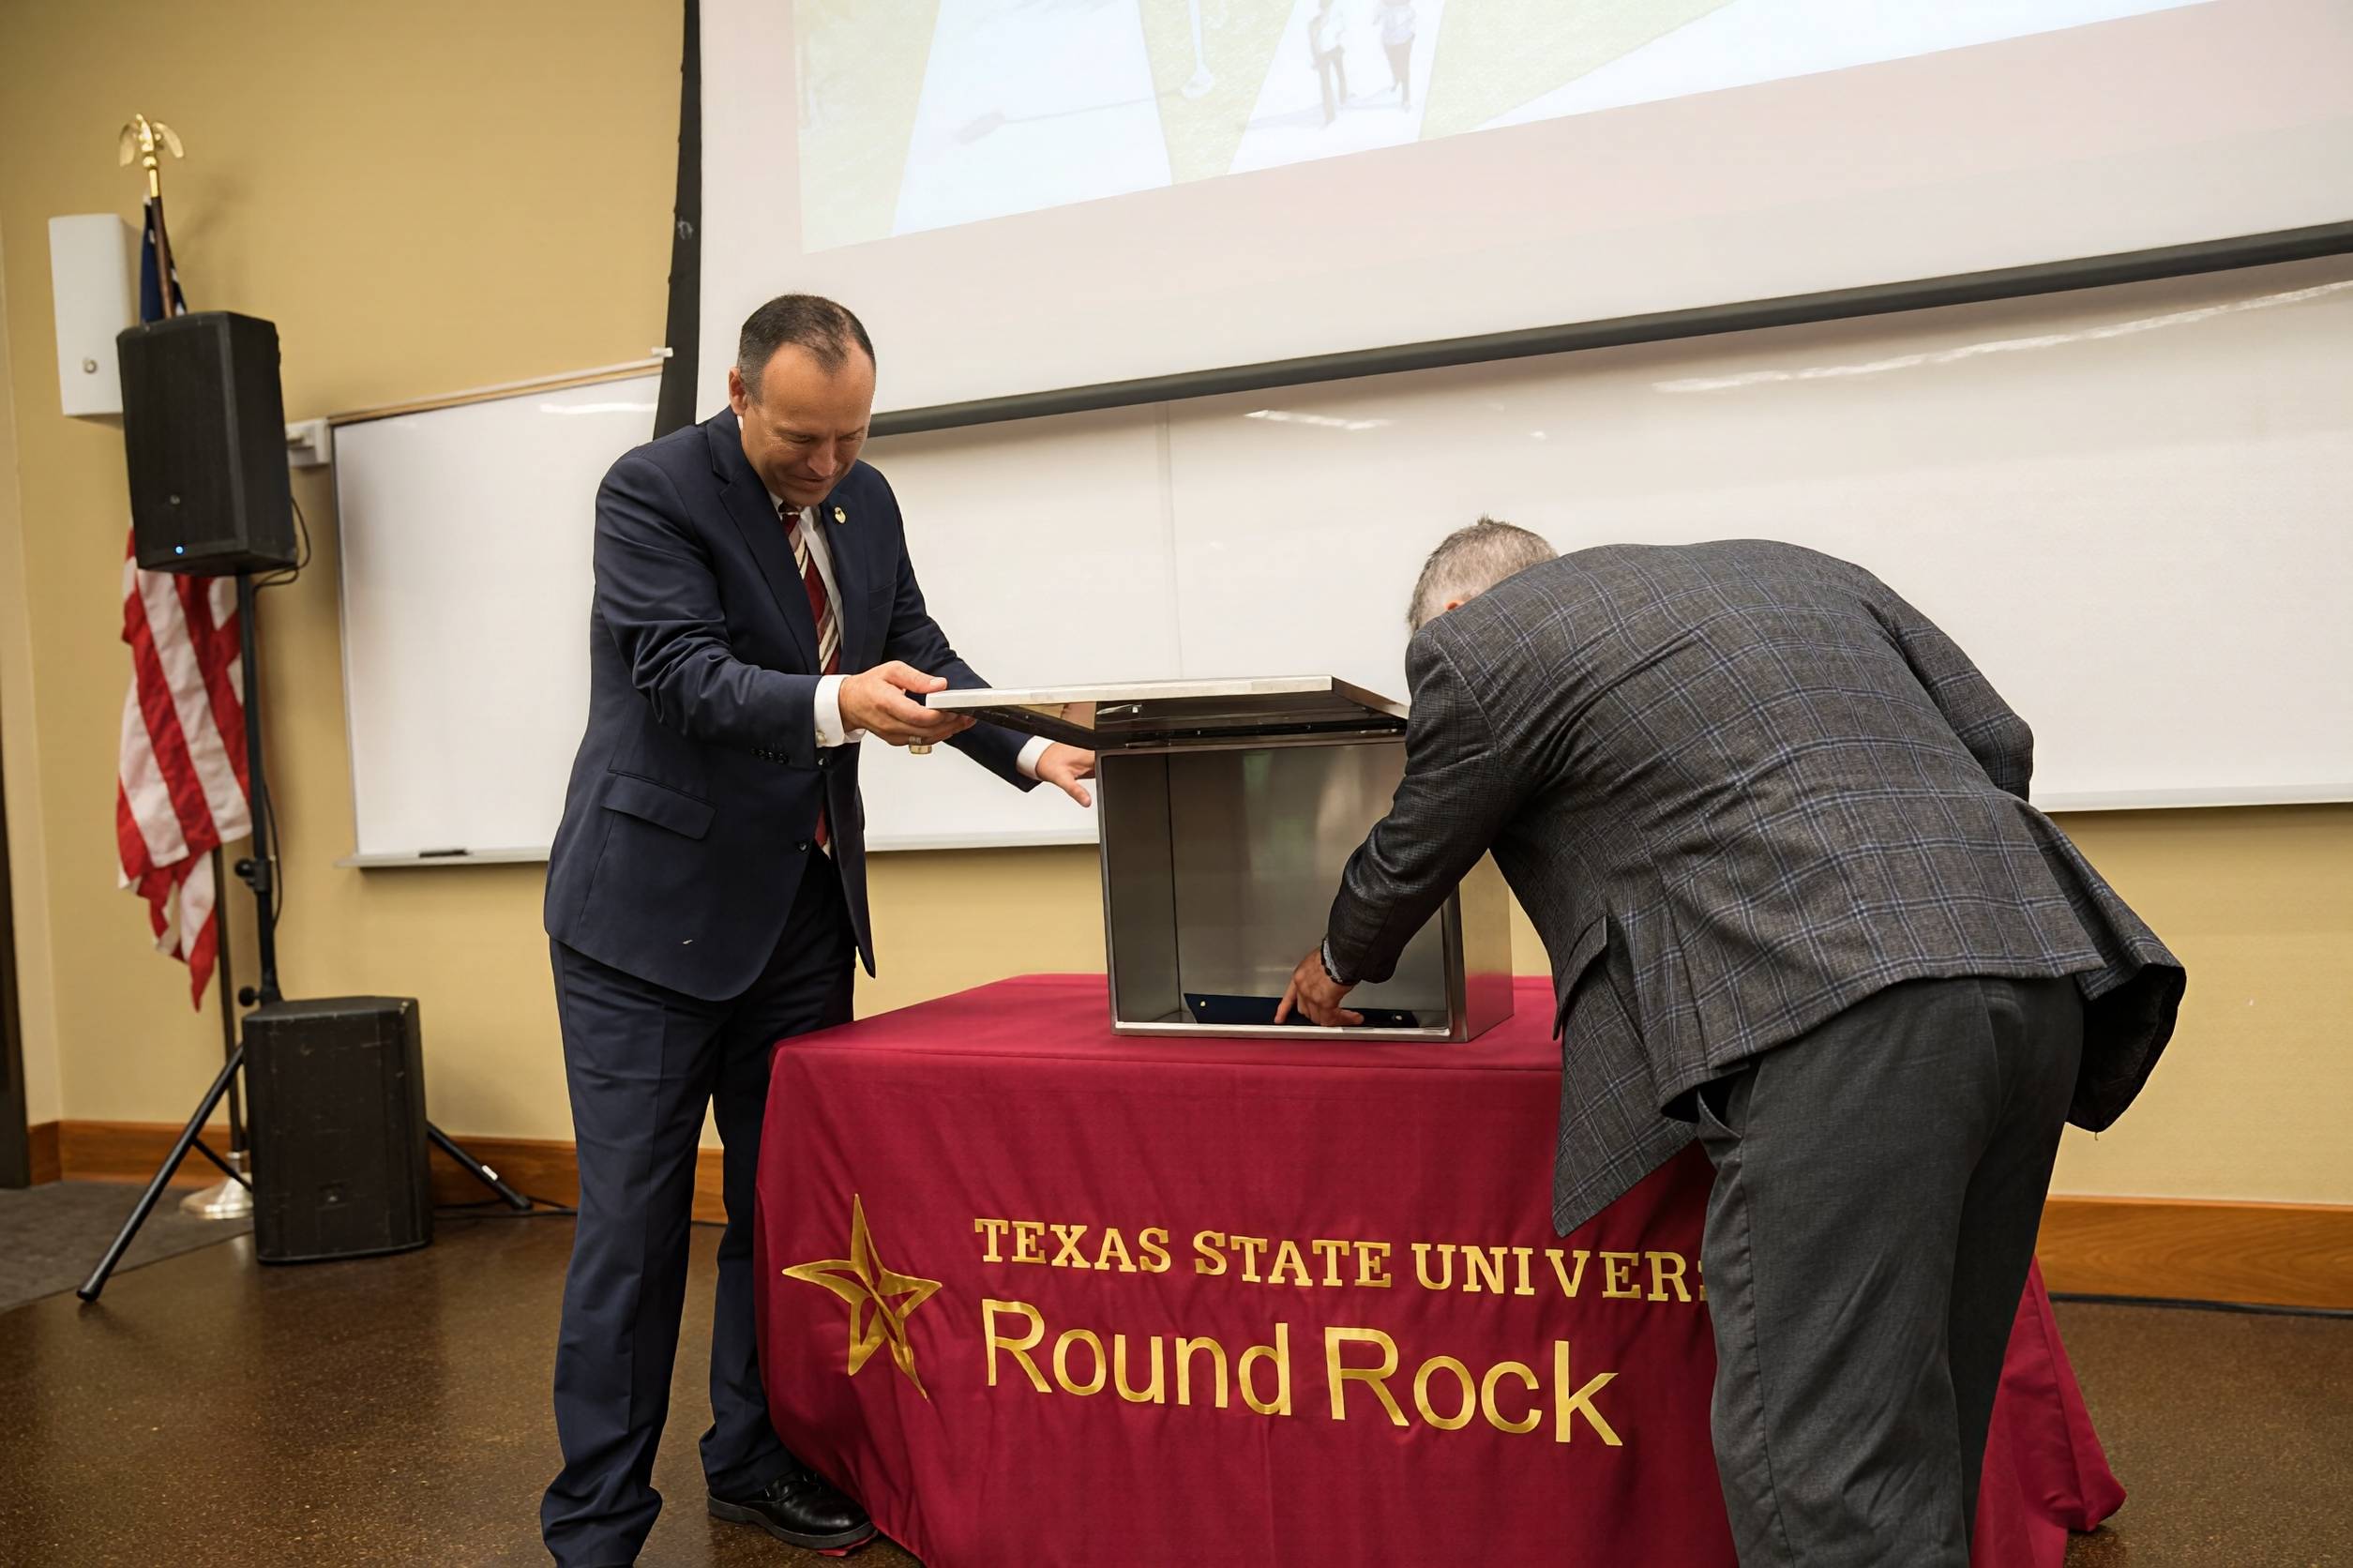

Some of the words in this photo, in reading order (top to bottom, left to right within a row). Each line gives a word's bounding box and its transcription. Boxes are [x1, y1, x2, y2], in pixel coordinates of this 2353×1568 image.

[973, 1218, 1171, 1274] TEXAS
[1192, 1229, 1392, 1289] STATE
[1410, 1243, 1708, 1303] UNIVER
[981, 1298, 1292, 1416] Round
[1324, 1326, 1624, 1446] Rock
